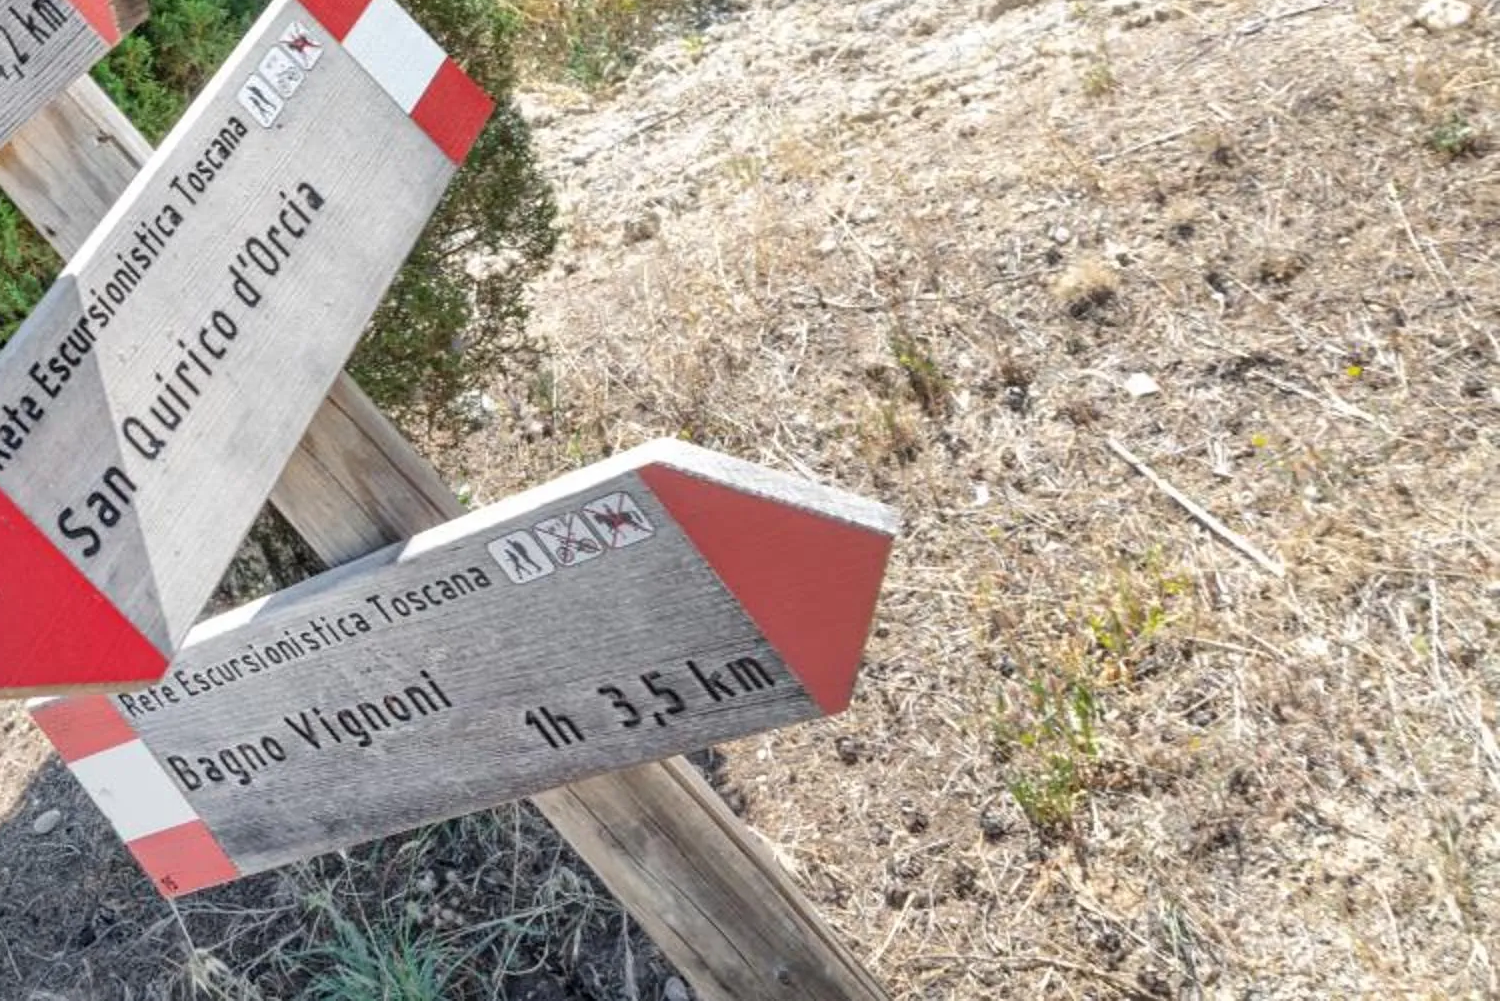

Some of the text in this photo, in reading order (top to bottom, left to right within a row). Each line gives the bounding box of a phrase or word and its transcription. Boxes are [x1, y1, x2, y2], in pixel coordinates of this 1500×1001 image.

[29, 203, 185, 399] Escursionistica
[169, 114, 250, 207] Toscana
[57, 178, 326, 557] San Quirico d'Orcia
[117, 565, 492, 719] Rete Escursionistica Toscana
[524, 655, 776, 749] 1h 3,5 km
[167, 670, 453, 792] Bagno Vignoni
